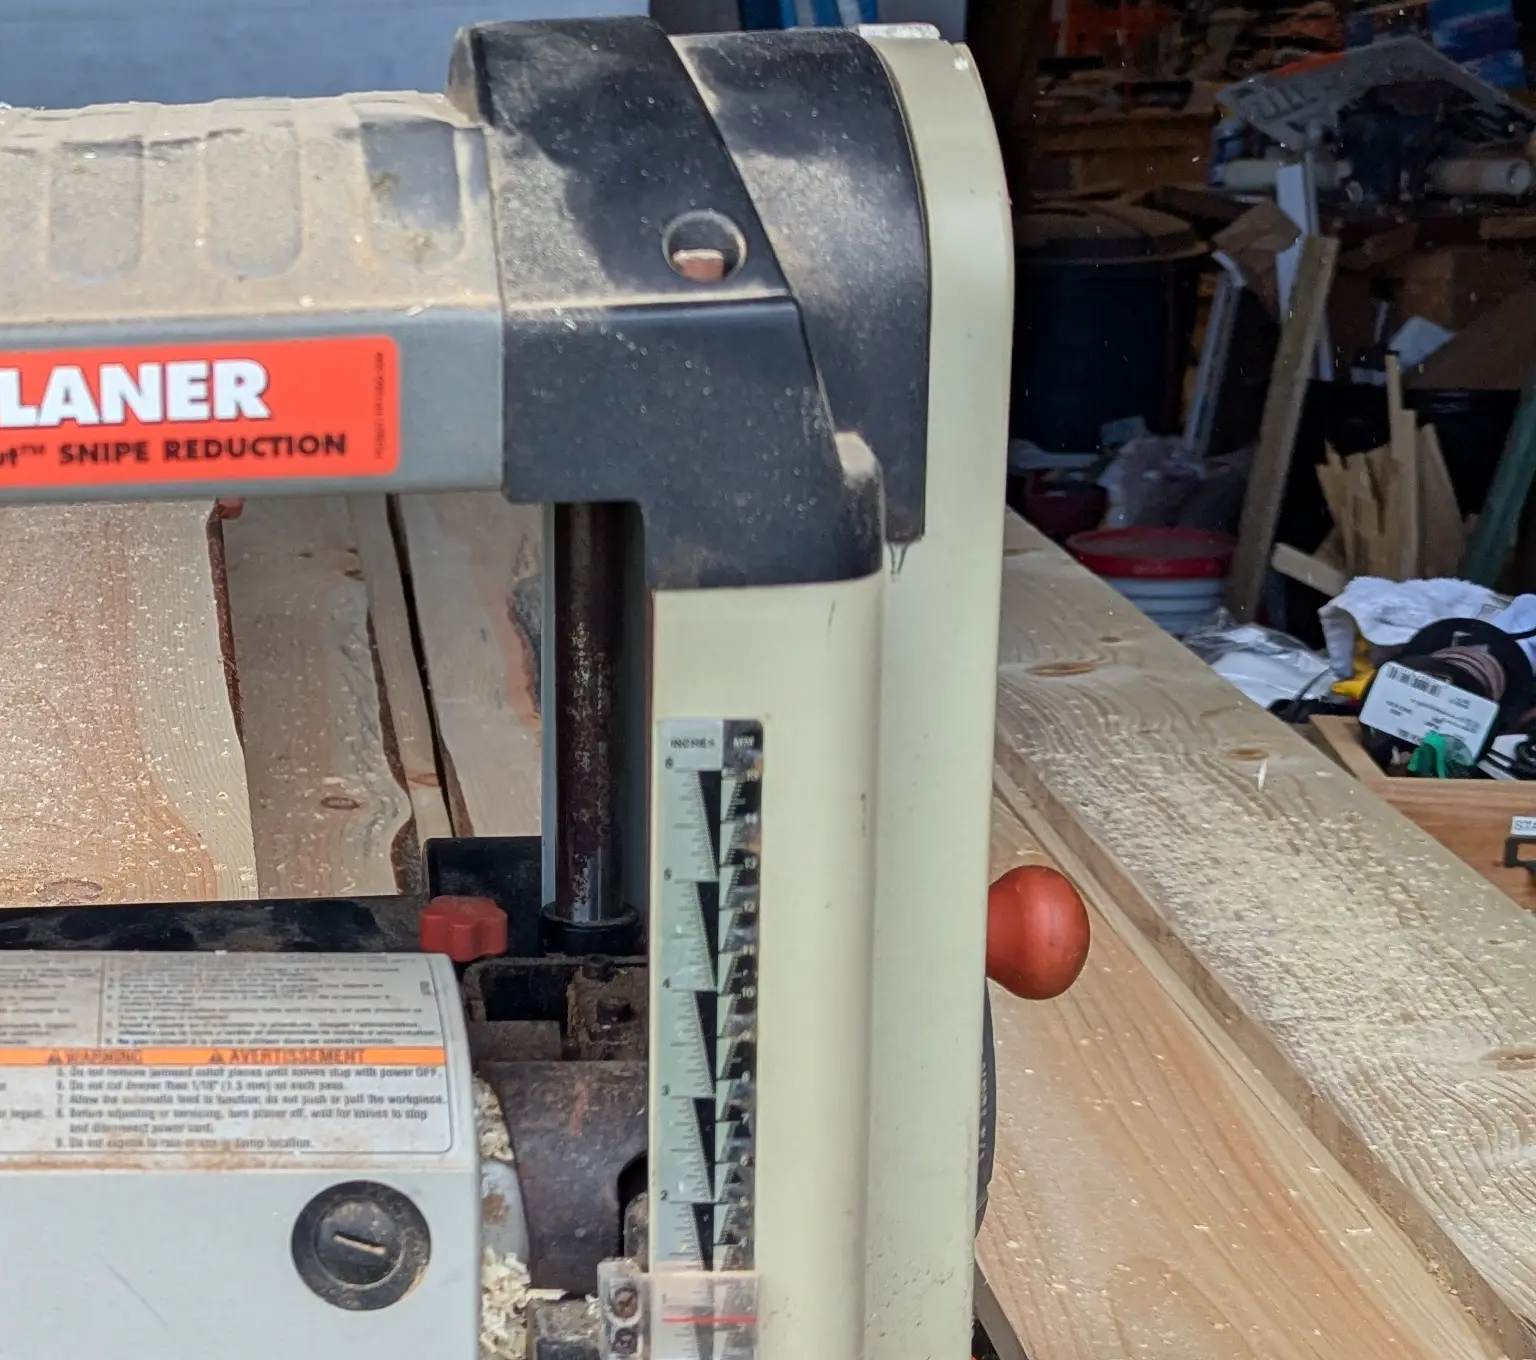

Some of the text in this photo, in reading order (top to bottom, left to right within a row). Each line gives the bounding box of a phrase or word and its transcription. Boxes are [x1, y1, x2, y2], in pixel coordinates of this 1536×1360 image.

[59, 441, 150, 464] SNIPE
[163, 433, 347, 462] REDUCTION
[660, 1191, 669, 1201] 2
